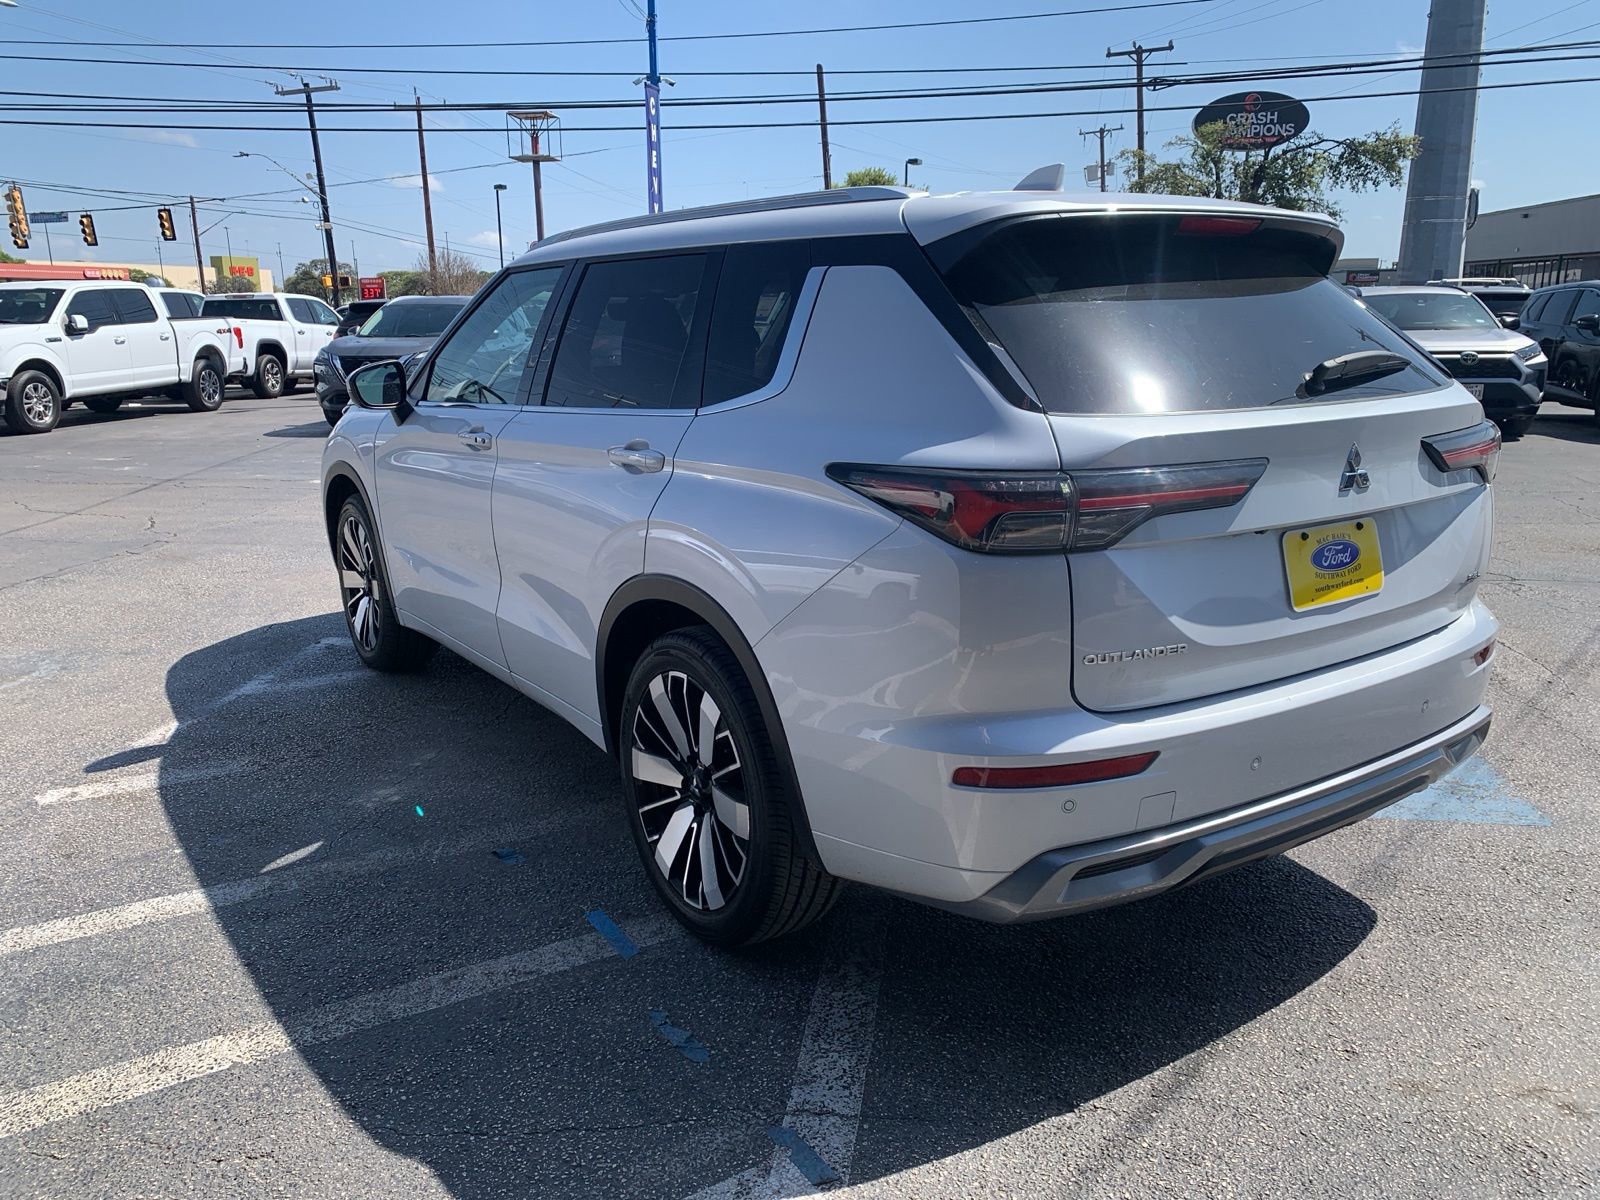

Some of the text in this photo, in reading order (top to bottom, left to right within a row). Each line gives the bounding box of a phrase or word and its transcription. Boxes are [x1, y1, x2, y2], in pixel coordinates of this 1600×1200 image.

[1227, 112, 1278, 123] CRASH
[650, 97, 659, 214] CHEVY
[1322, 545, 1352, 566] Ford
[1315, 563, 1362, 580] SOUTHWAY FORD
[1315, 577, 1365, 593] southwayford.com
[1083, 643, 1188, 665] OUTLANDER
